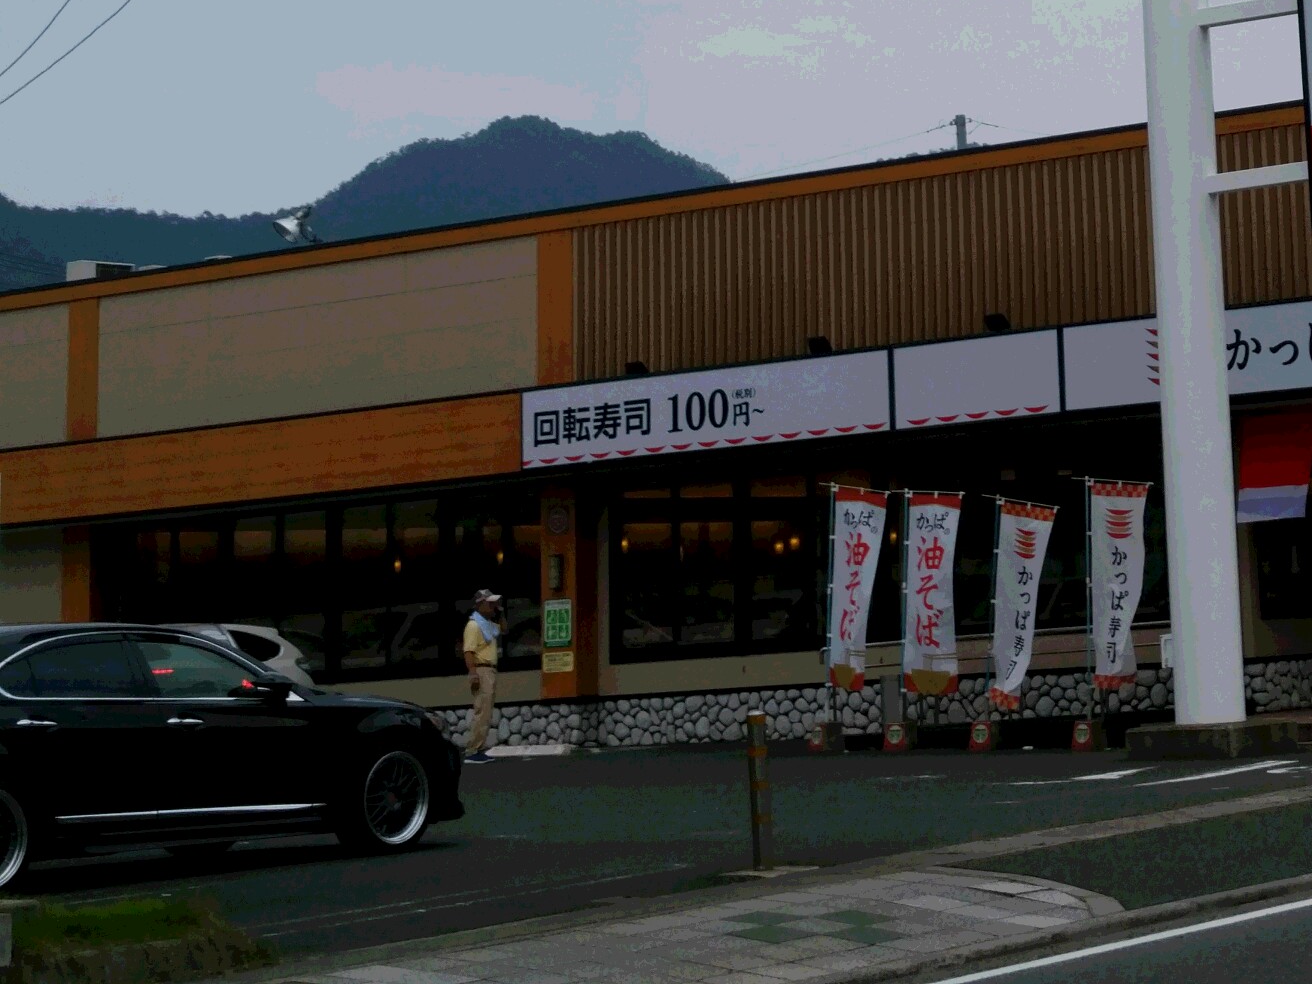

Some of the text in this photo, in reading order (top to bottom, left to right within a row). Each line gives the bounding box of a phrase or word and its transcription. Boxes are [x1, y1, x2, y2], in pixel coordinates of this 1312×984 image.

[533, 398, 651, 447] 回転寿司
[916, 536, 944, 648] 油そば
[1106, 545, 1129, 664] かっぱ寿司
